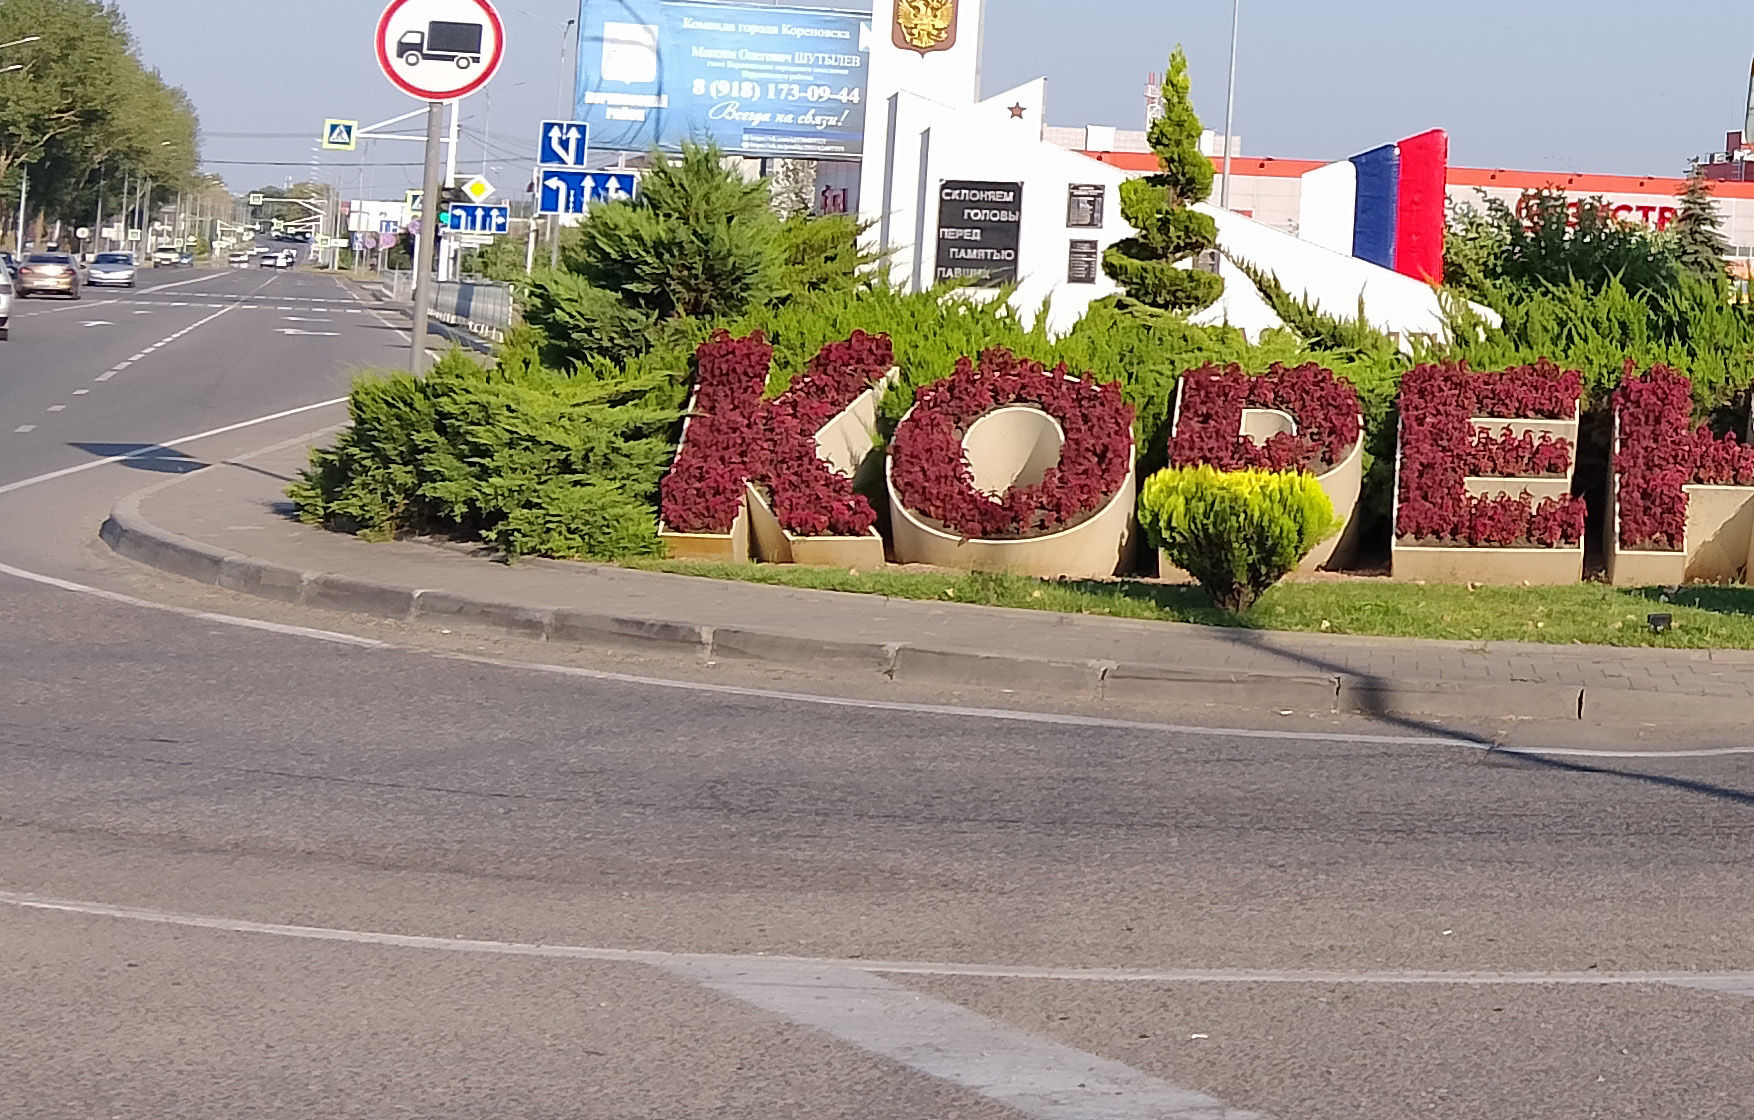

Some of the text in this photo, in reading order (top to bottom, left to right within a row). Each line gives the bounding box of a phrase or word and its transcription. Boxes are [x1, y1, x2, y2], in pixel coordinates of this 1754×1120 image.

[794, 51, 861, 67] ШУТЫЛЕВ
[692, 77, 861, 104] 8 (918) 173-09-44
[708, 100, 850, 130] Всегда на связи!
[941, 188, 1014, 202] СКЛОНЯЕМ
[963, 209, 1019, 221] ГОЛОВЫ
[939, 228, 982, 241] ПЕРЕД
[949, 248, 1015, 260] ПАМЯТЬЮ
